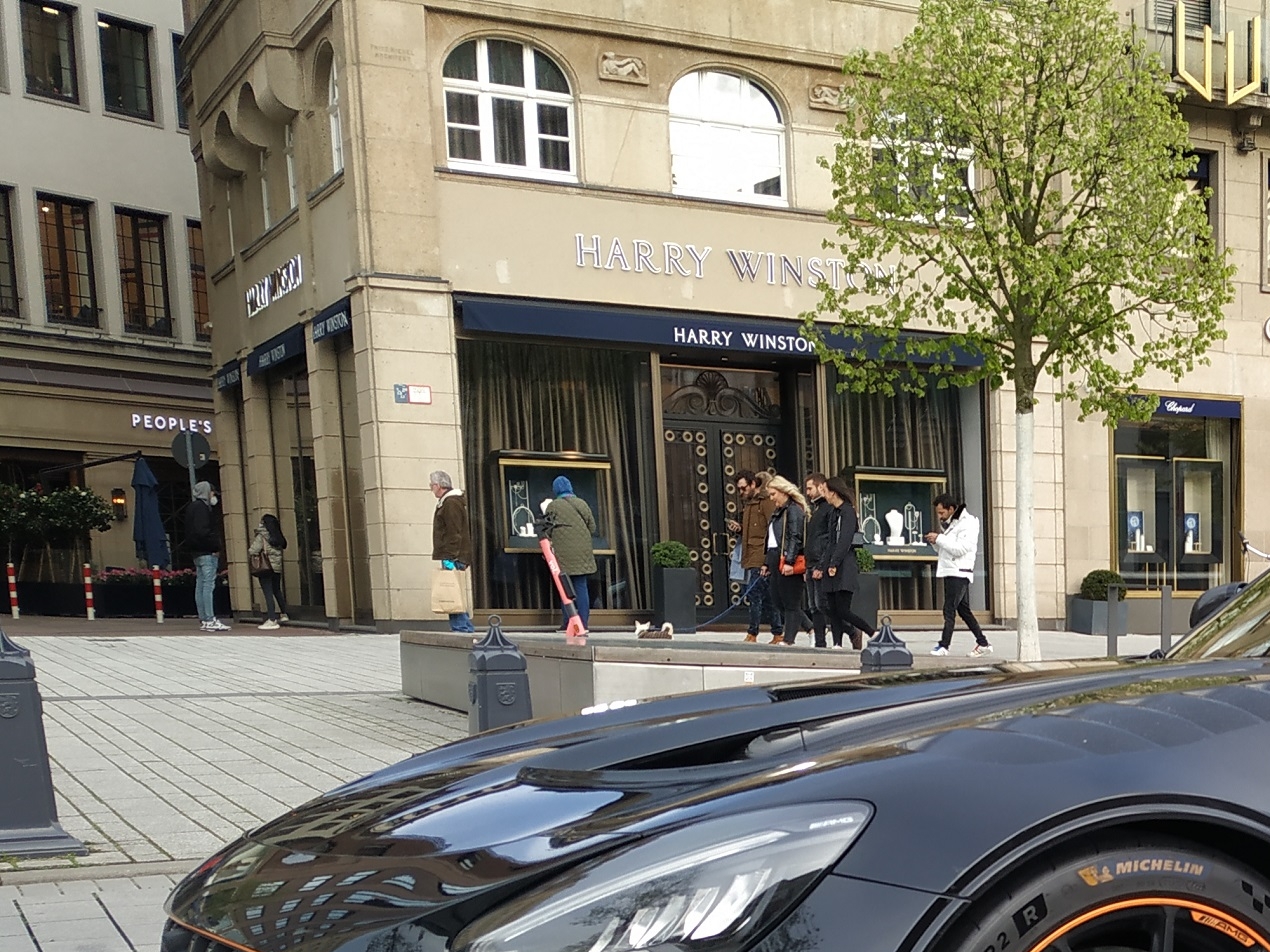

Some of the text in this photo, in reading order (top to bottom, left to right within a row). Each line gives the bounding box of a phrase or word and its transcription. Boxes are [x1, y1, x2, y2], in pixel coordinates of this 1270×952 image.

[574, 233, 898, 295] HARRY WINSTON
[674, 327, 733, 348] HARRY
[1164, 400, 1197, 415] Chopard
[131, 413, 212, 434] PEOPLE'S
[1115, 858, 1205, 876] MICHELIN
[996, 932, 1010, 950] 2
[1022, 905, 1039, 926] R
[1213, 920, 1249, 944] AMG
